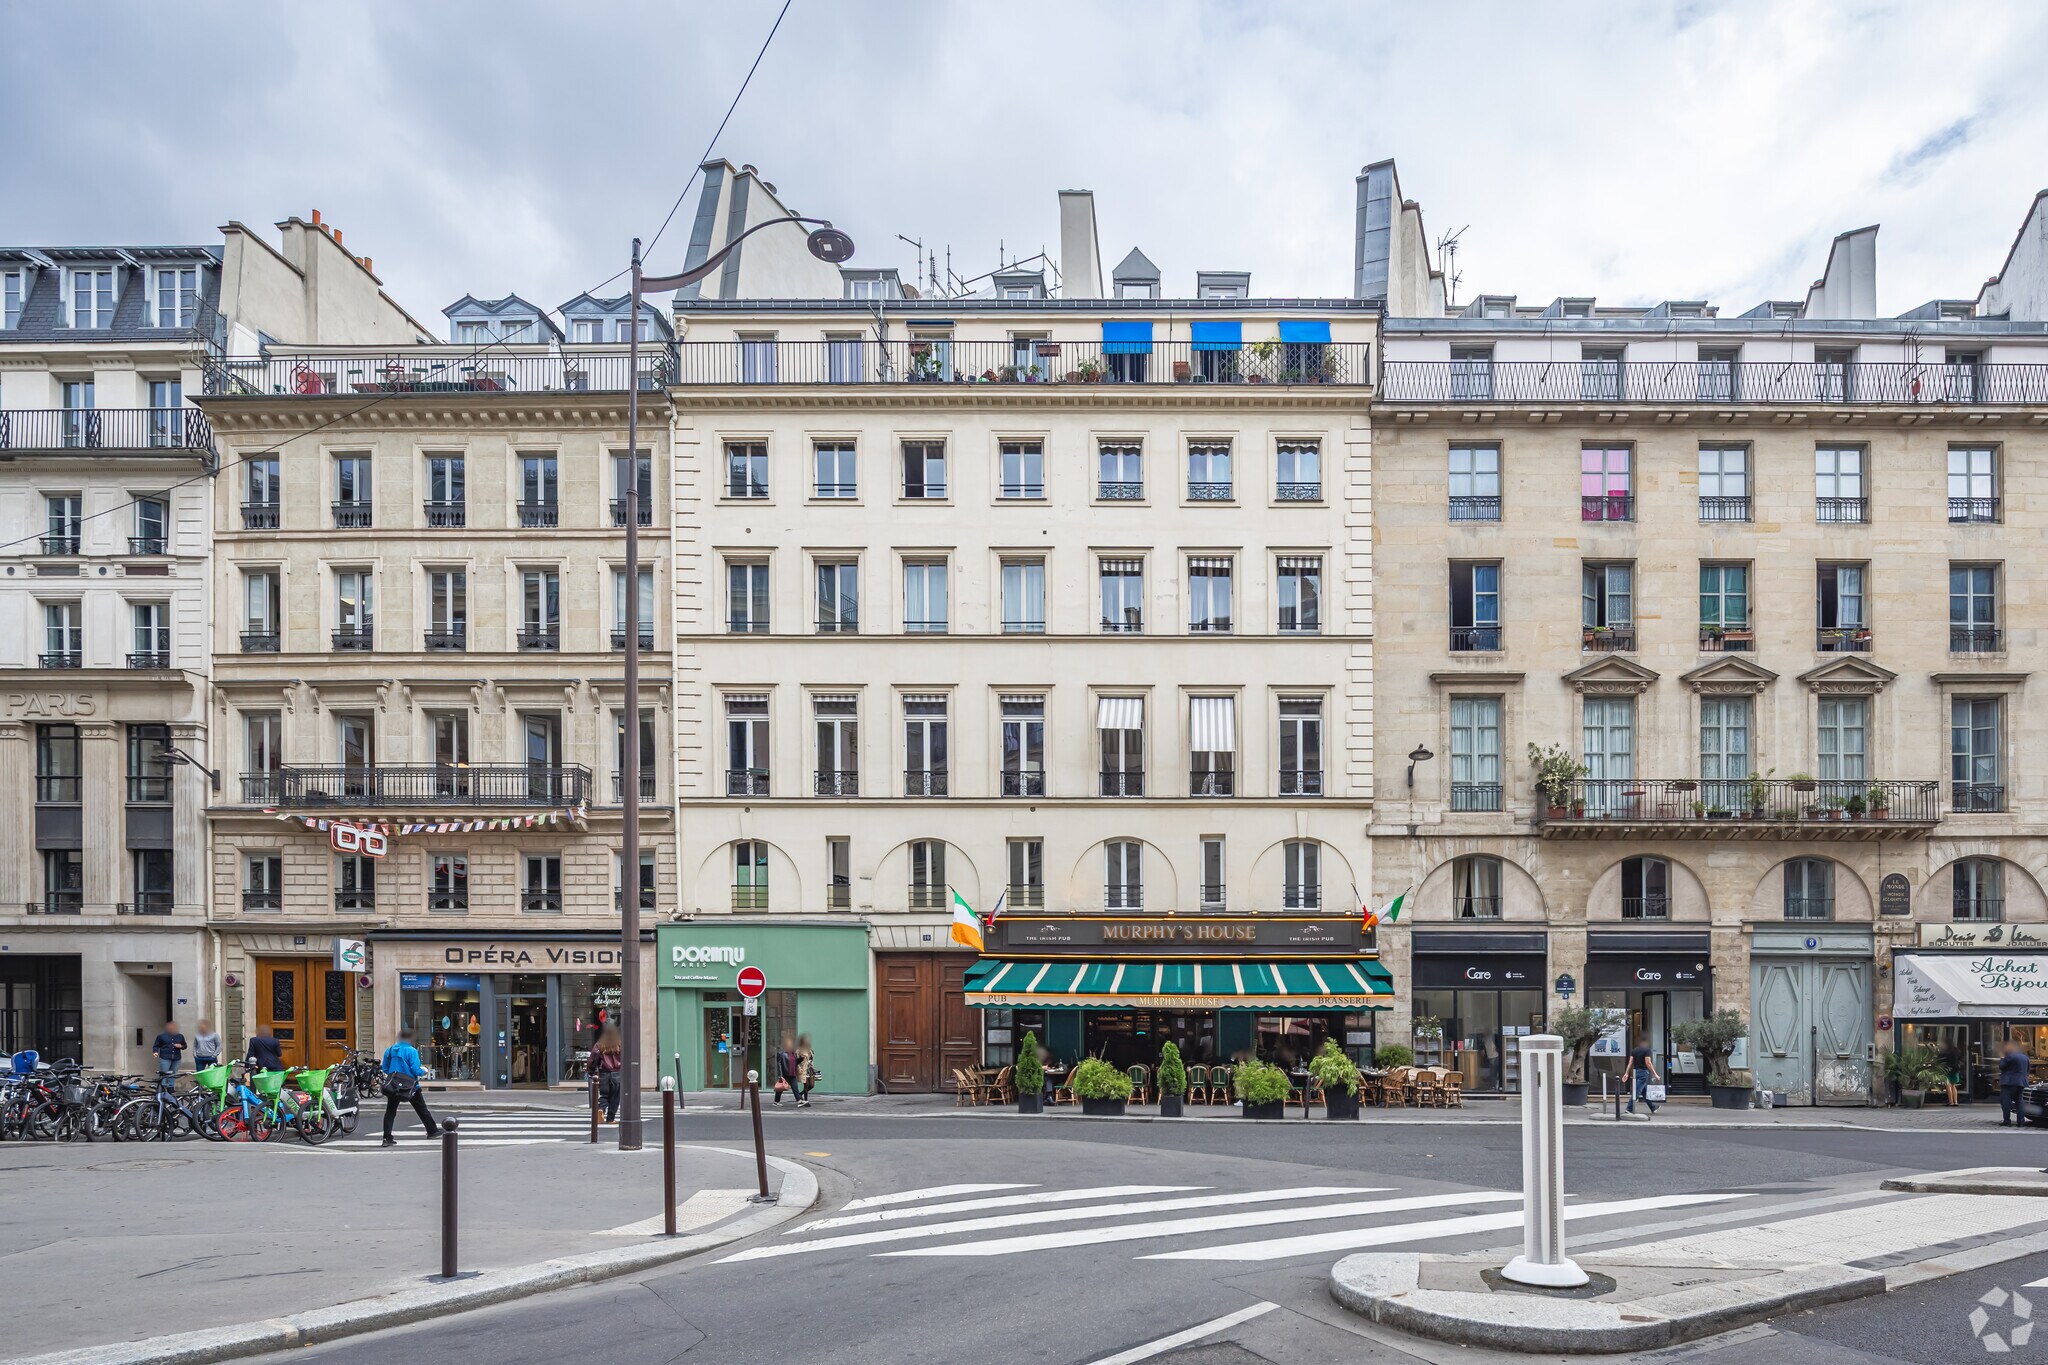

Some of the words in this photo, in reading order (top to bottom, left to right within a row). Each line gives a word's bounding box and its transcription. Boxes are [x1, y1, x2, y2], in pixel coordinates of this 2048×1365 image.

[6, 693, 96, 717] PARIS
[1198, 925, 1257, 940] HOUSE
[446, 945, 532, 963] OPÉRA
[1971, 957, 2038, 973] Achat
[1188, 998, 1219, 1006] HOUSE
[2018, 1007, 2040, 1016] Denis
